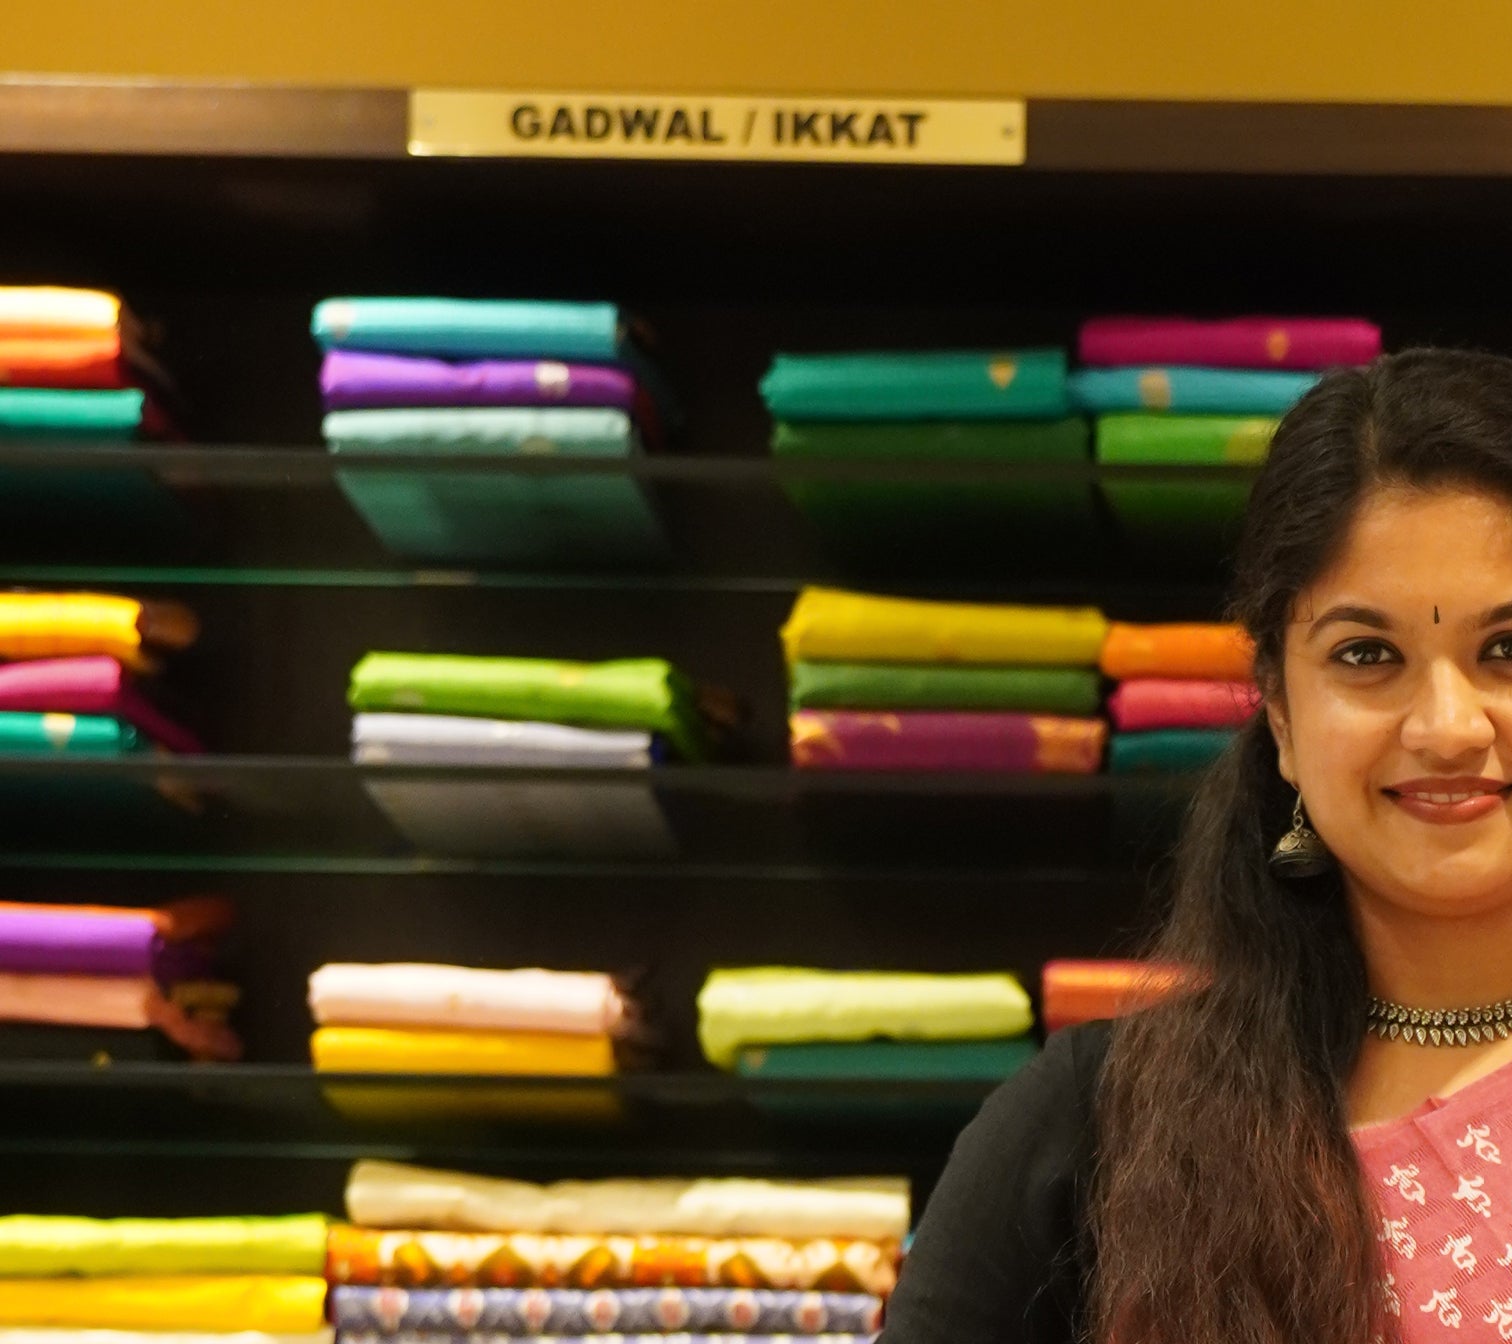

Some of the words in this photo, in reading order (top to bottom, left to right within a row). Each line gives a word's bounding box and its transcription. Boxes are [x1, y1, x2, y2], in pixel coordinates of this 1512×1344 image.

[510, 105, 725, 144] GADWAL
[741, 108, 759, 145] /
[773, 110, 928, 147] IKKAT
